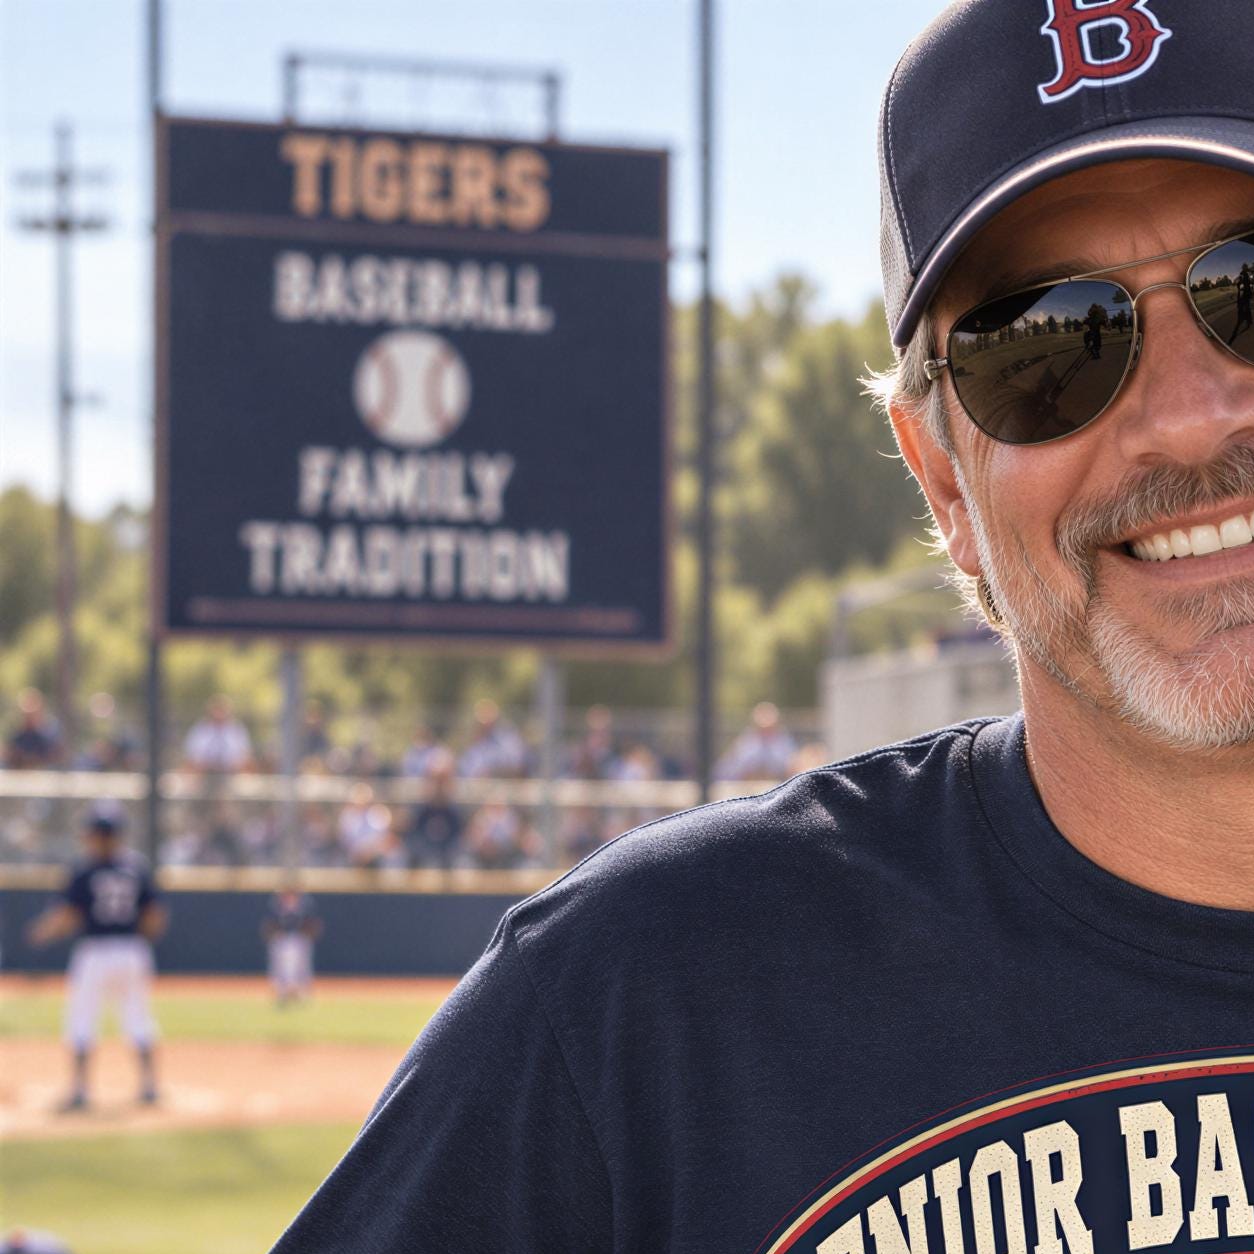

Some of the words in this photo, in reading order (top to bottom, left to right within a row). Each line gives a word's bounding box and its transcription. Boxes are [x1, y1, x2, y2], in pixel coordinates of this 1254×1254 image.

[1037, 0, 1173, 104] B
[283, 136, 548, 229] TIGERS
[274, 253, 553, 331] BASEBALL
[299, 447, 513, 521] FAMILY
[244, 523, 568, 599] TRADITION
